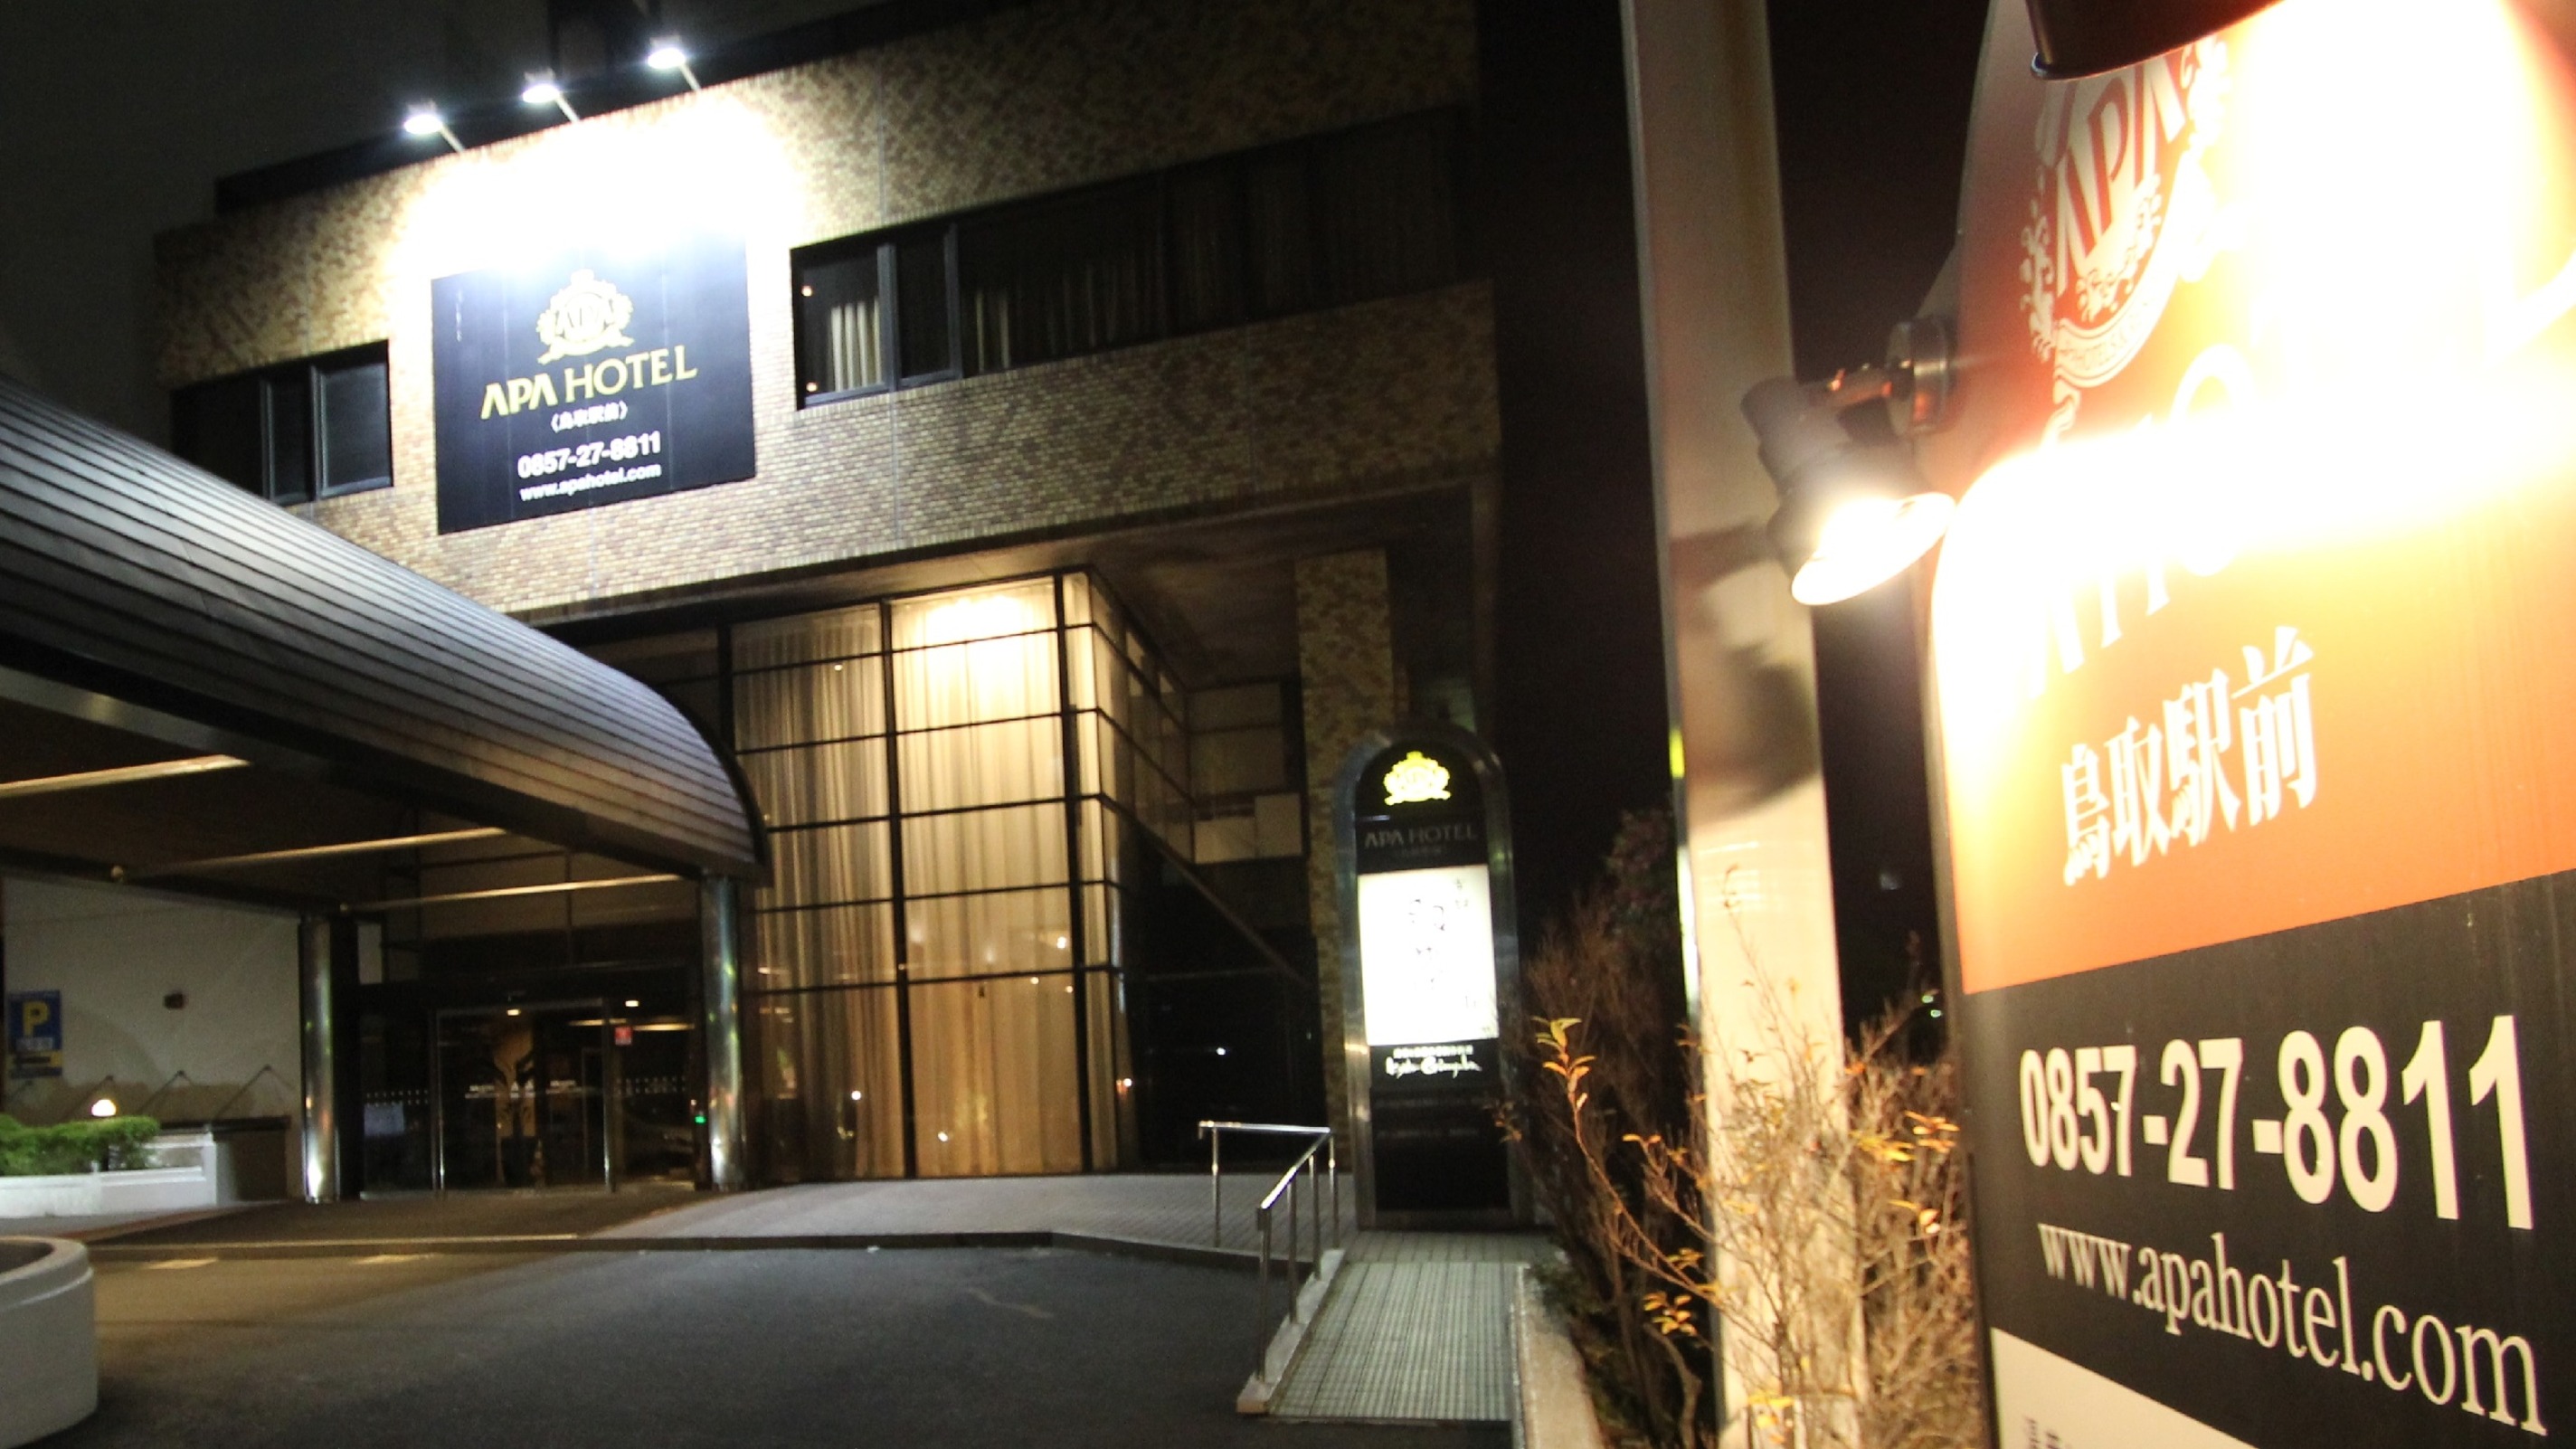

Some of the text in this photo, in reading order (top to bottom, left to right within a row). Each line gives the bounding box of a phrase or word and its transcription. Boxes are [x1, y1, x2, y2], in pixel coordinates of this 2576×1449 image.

[480, 374, 558, 420] APA
[564, 345, 697, 403] HOTEL
[517, 431, 661, 478] 0857-27-8811
[519, 463, 662, 501] www.apahotel.com
[2060, 625, 2318, 886] 鳥取駅前
[1365, 823, 1477, 848] APA HOTEL
[22, 1000, 50, 1037] P
[2020, 1015, 2533, 1230] 0857-27-8811
[2038, 1224, 2548, 1436] www.apahotel.com
